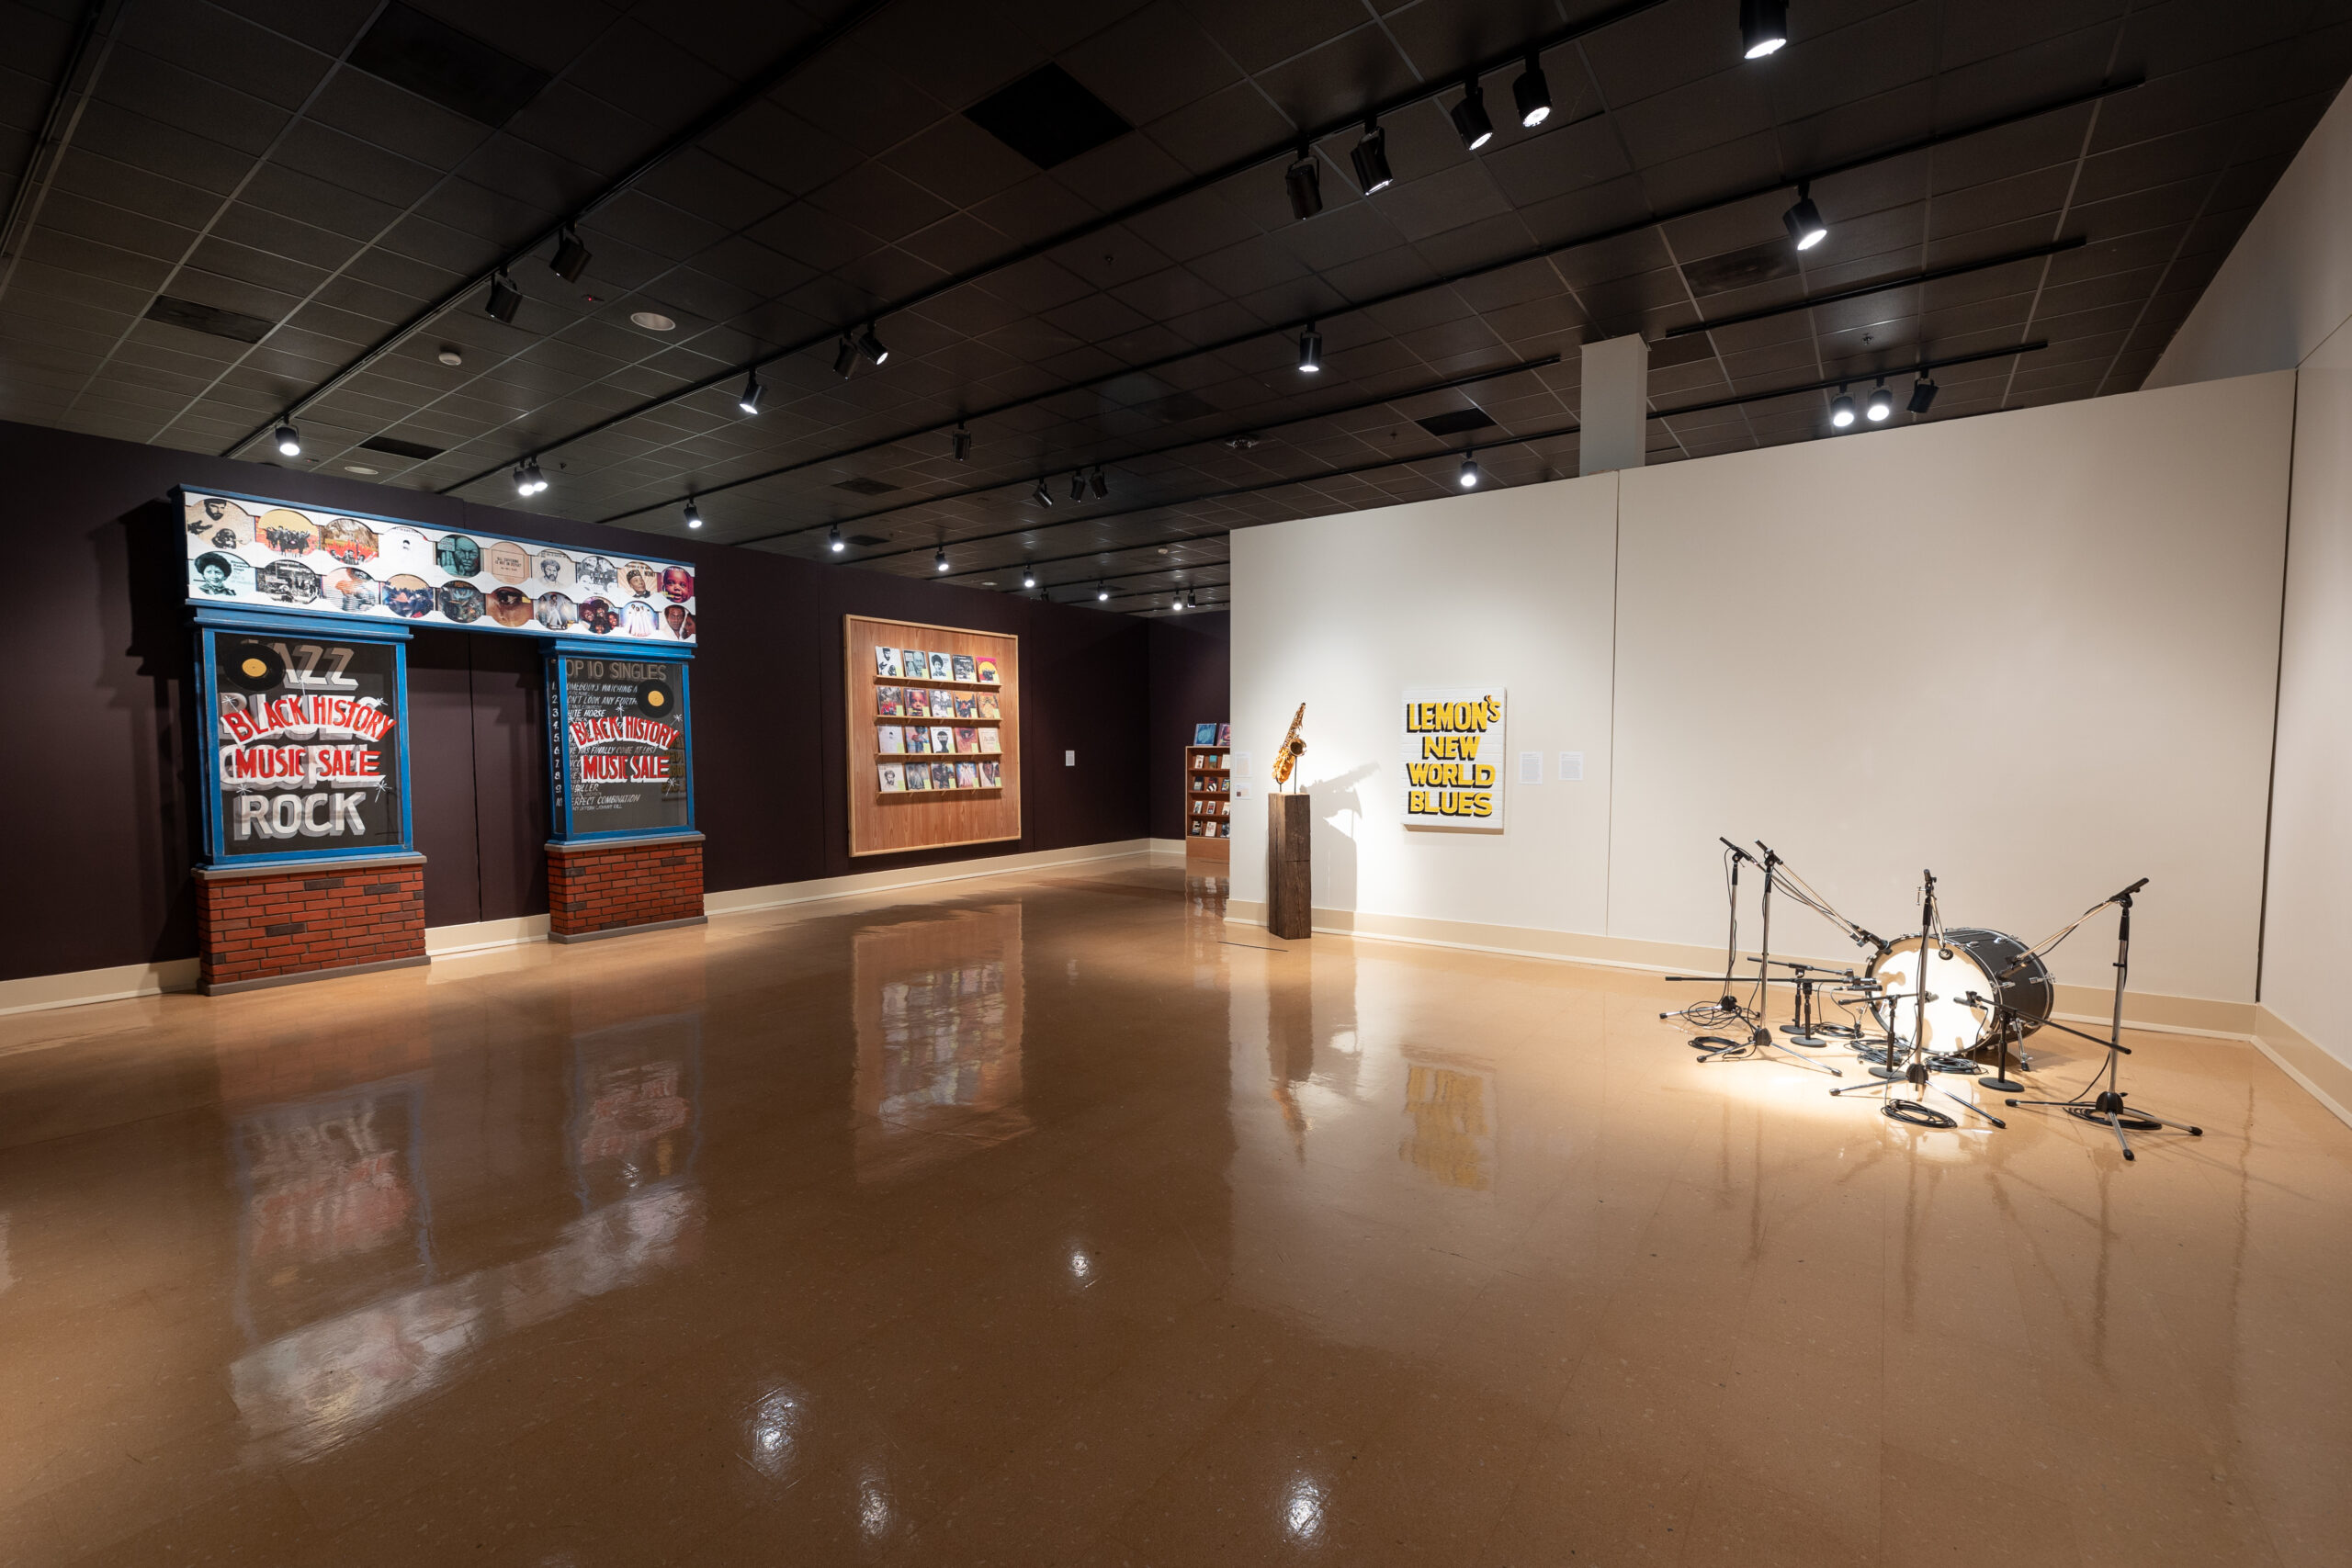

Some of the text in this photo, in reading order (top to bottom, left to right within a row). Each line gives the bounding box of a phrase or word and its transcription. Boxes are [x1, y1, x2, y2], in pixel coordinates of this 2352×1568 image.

[566, 660, 666, 681] OP 10 SINGLES
[567, 695, 583, 705] ON'T
[583, 695, 601, 705] LOOK
[601, 696, 615, 705] ANY
[568, 709, 582, 717] HITE
[583, 709, 606, 717] HORSE
[220, 695, 397, 745] BLACK HISTORY
[1407, 694, 1501, 733] LEMON'S
[570, 716, 624, 749] BLACK
[623, 716, 680, 750] HISTORY
[591, 746, 615, 754] FINALLY
[1422, 736, 1481, 761] NEW
[236, 749, 383, 781] MUSIC SALE
[582, 755, 671, 783] MUSIC SALE
[1407, 762, 1496, 788] WORLD
[571, 783, 599, 792] HRILLER
[571, 796, 595, 807] ERFECT
[597, 794, 641, 805] COMBINATION
[234, 792, 366, 840] ROCK
[1408, 791, 1493, 817] BLUES
